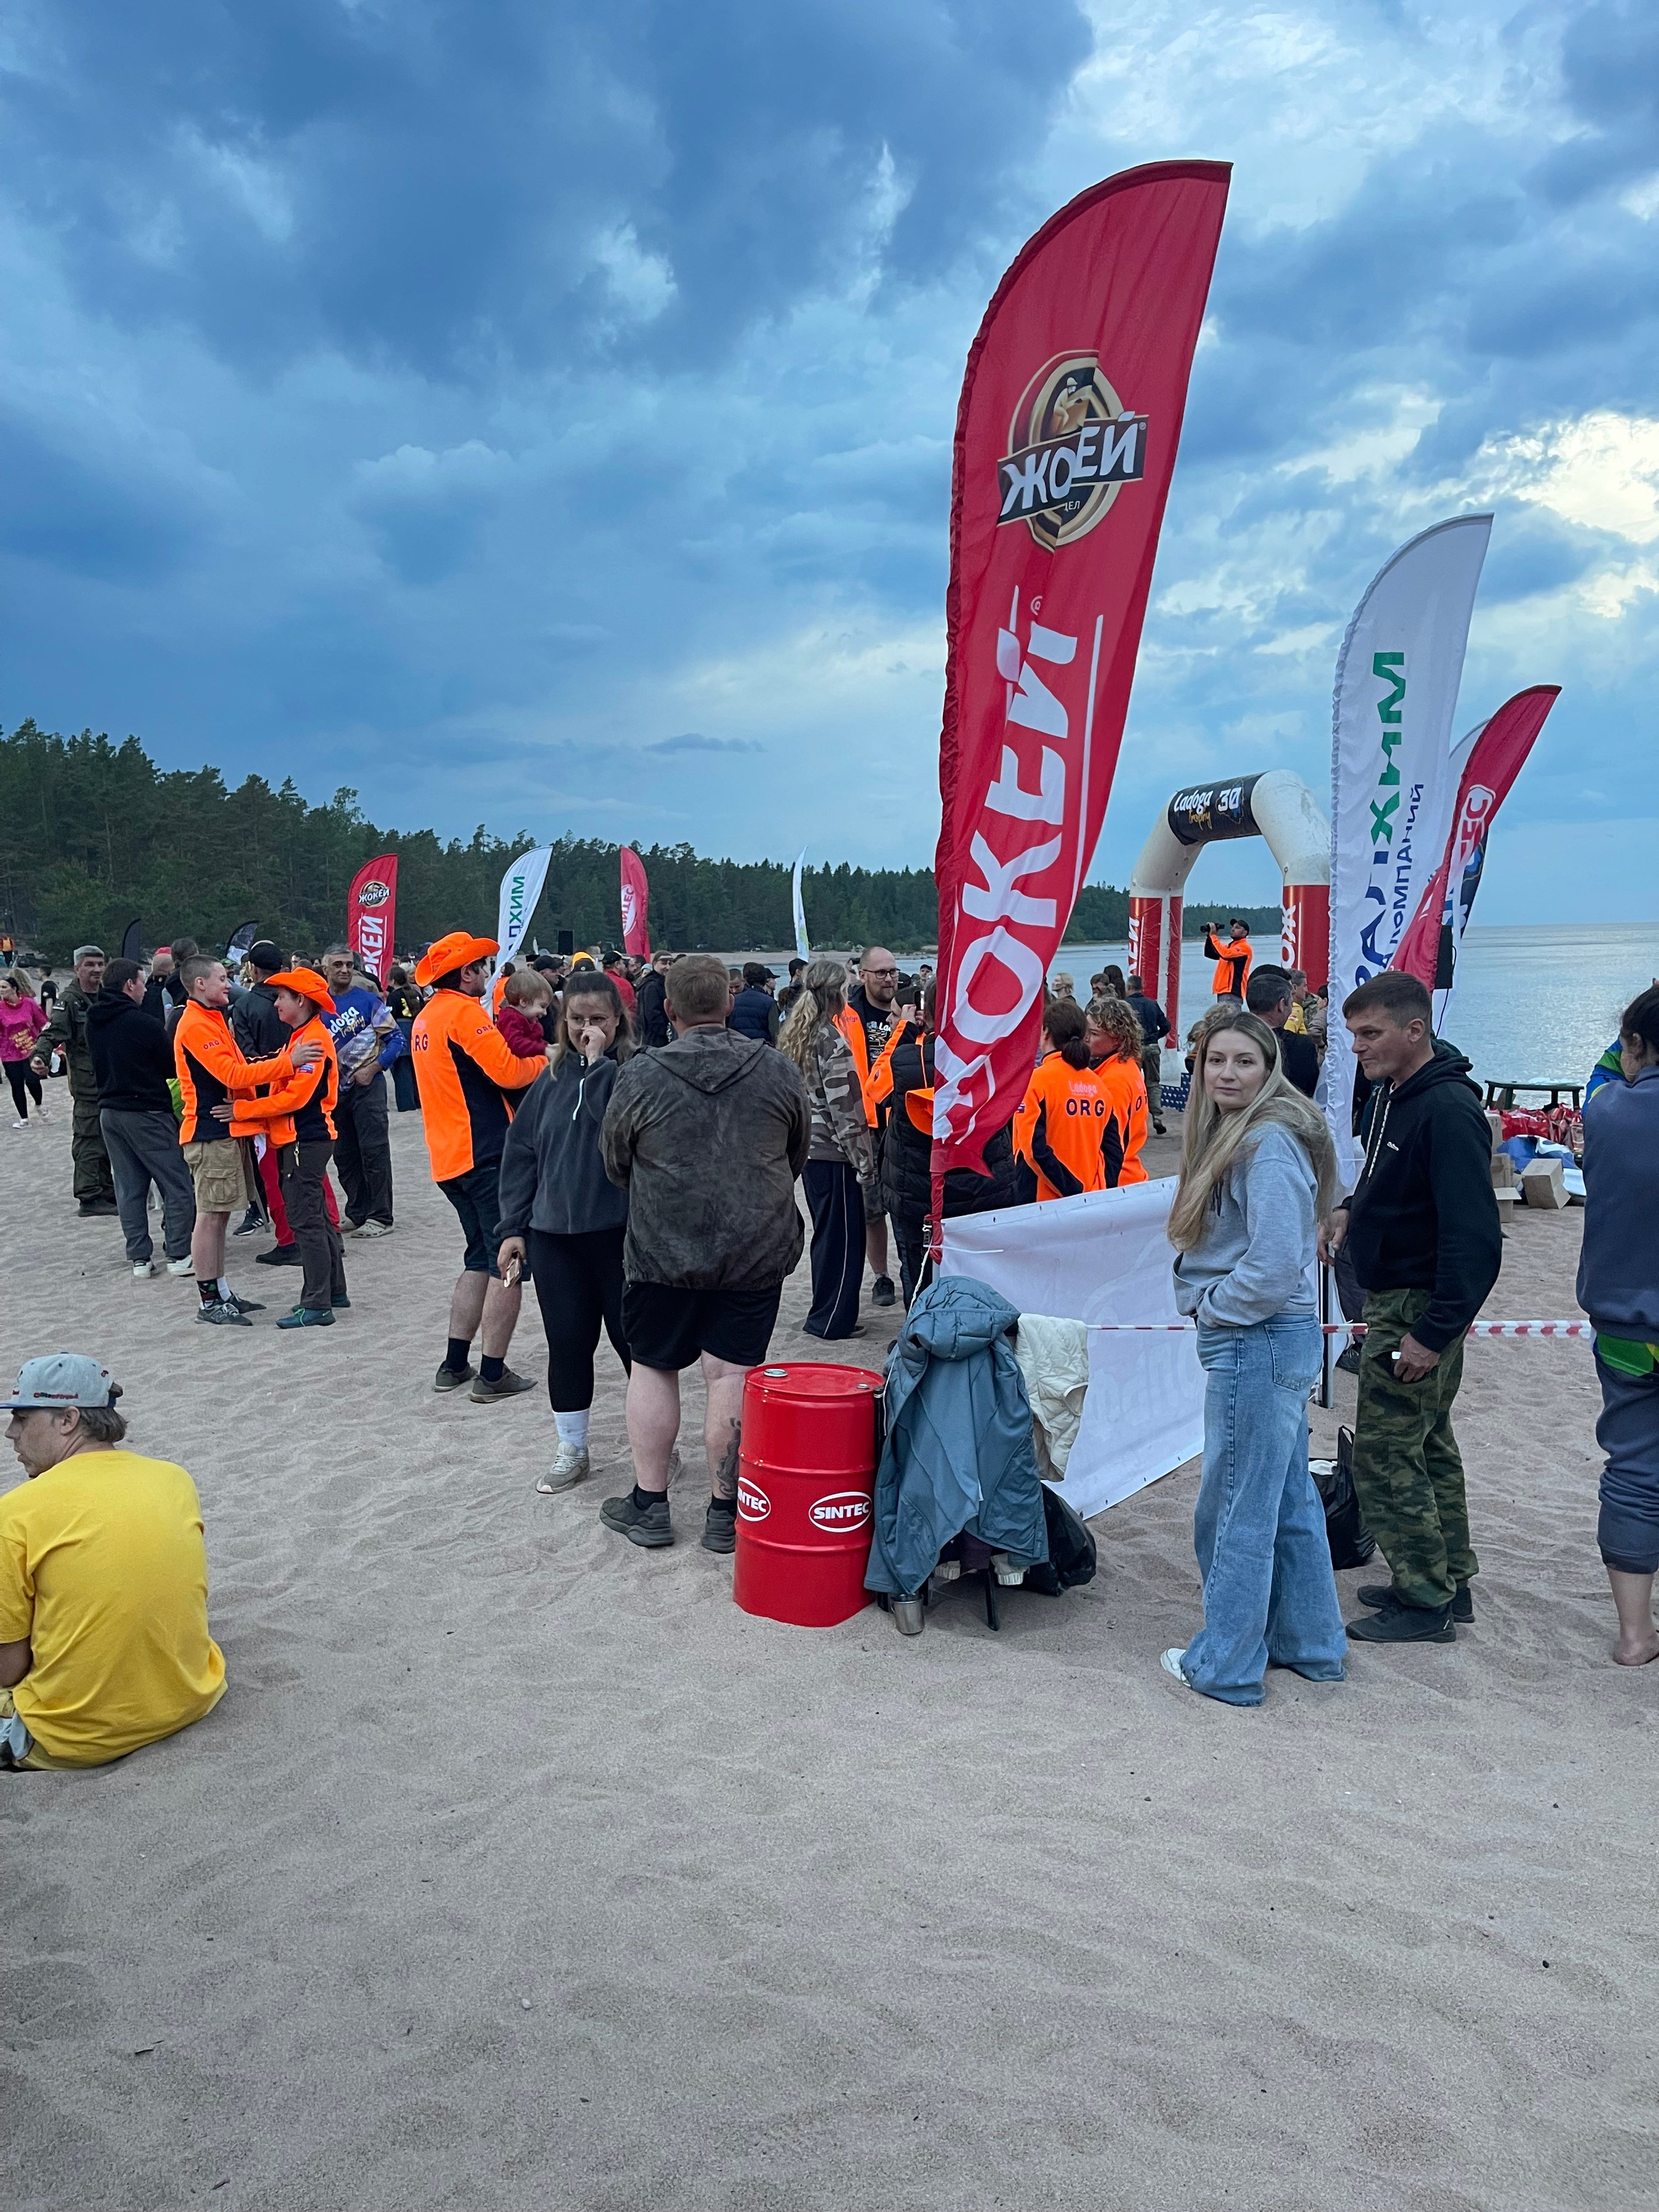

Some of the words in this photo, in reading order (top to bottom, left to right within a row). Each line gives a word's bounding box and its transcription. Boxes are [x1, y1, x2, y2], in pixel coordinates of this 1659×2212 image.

[1000, 411, 1138, 516] ЖОЕЙ
[1174, 789, 1213, 815] Ladoga
[1218, 787, 1242, 811] 30
[1189, 810, 1212, 830] Trophy
[412, 1033, 428, 1052] RG
[1066, 1098, 1104, 1117] ORG
[813, 1501, 870, 1520] SINTEC
